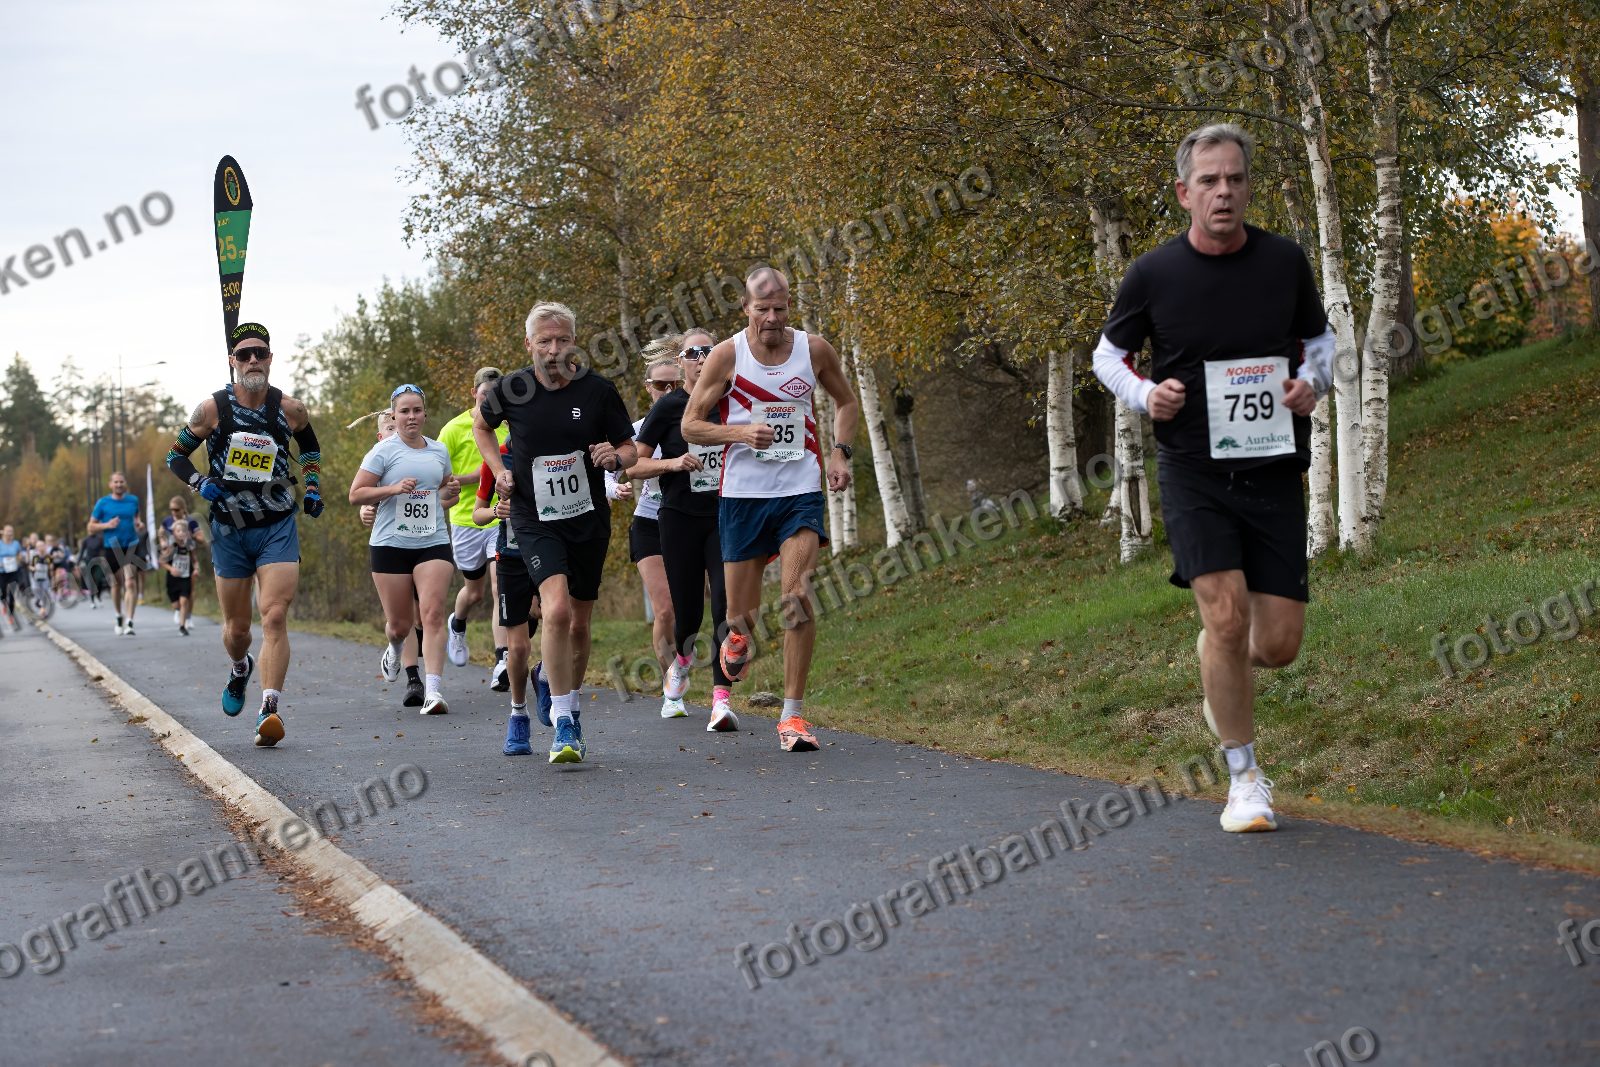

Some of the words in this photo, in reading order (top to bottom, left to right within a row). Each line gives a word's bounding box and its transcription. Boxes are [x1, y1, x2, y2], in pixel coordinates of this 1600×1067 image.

[1226, 364, 1275, 376] NORGES
[1231, 375, 1267, 385] LØPET
[1224, 391, 1274, 422] 759
[767, 423, 794, 444] 35
[1245, 432, 1291, 446] Aurskog
[231, 450, 270, 470] PACE
[544, 456, 577, 467] NORGES
[547, 464, 572, 473] LØPET
[546, 474, 579, 497] 110
[404, 502, 429, 519] 963
